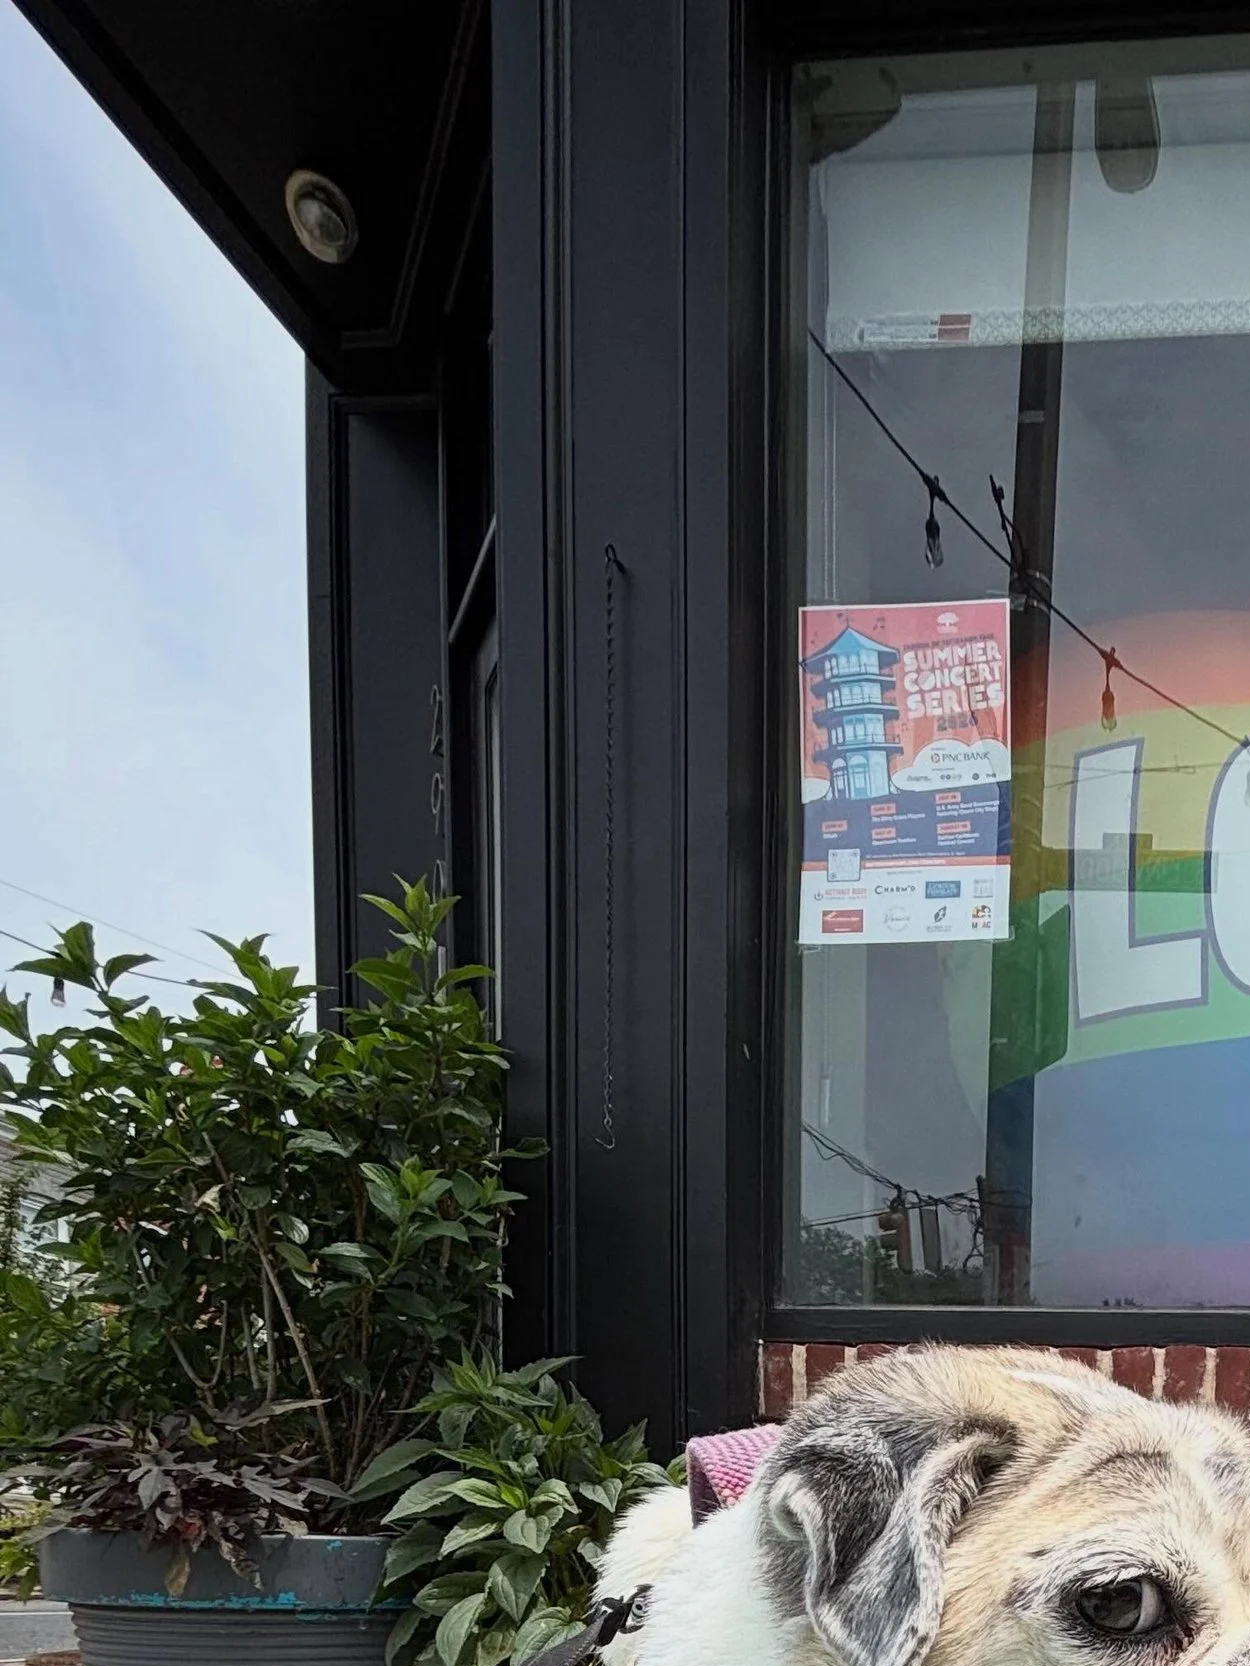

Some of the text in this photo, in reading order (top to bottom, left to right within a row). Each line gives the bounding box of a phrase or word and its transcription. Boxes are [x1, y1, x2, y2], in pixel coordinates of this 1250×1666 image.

[903, 640, 1002, 672] SUMMER
[904, 661, 1002, 693] CONCERT
[906, 683, 1003, 719] SERIES
[963, 751, 990, 761] BANK
